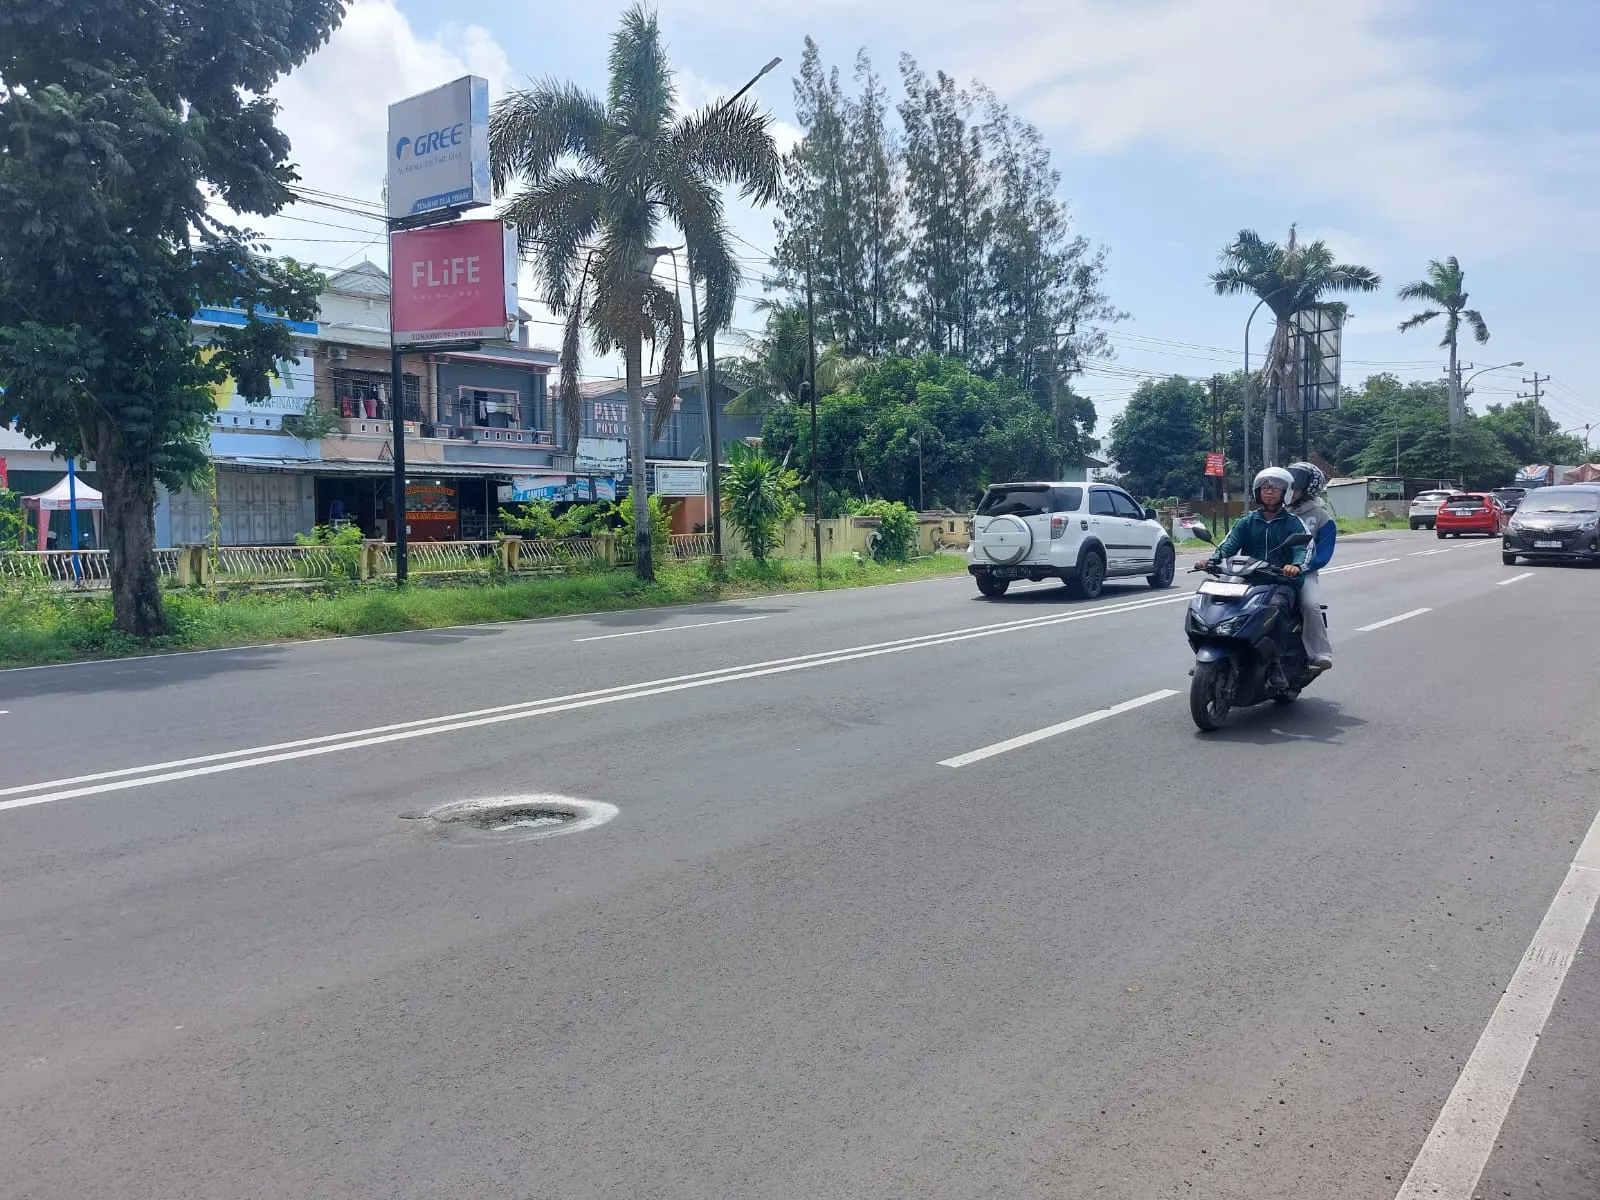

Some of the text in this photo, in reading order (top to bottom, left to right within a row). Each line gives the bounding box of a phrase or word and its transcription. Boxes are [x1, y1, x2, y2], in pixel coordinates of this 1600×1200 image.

[414, 123, 463, 156] GREE
[460, 329, 483, 337] TEKNIK
[596, 422, 619, 434] POTO
